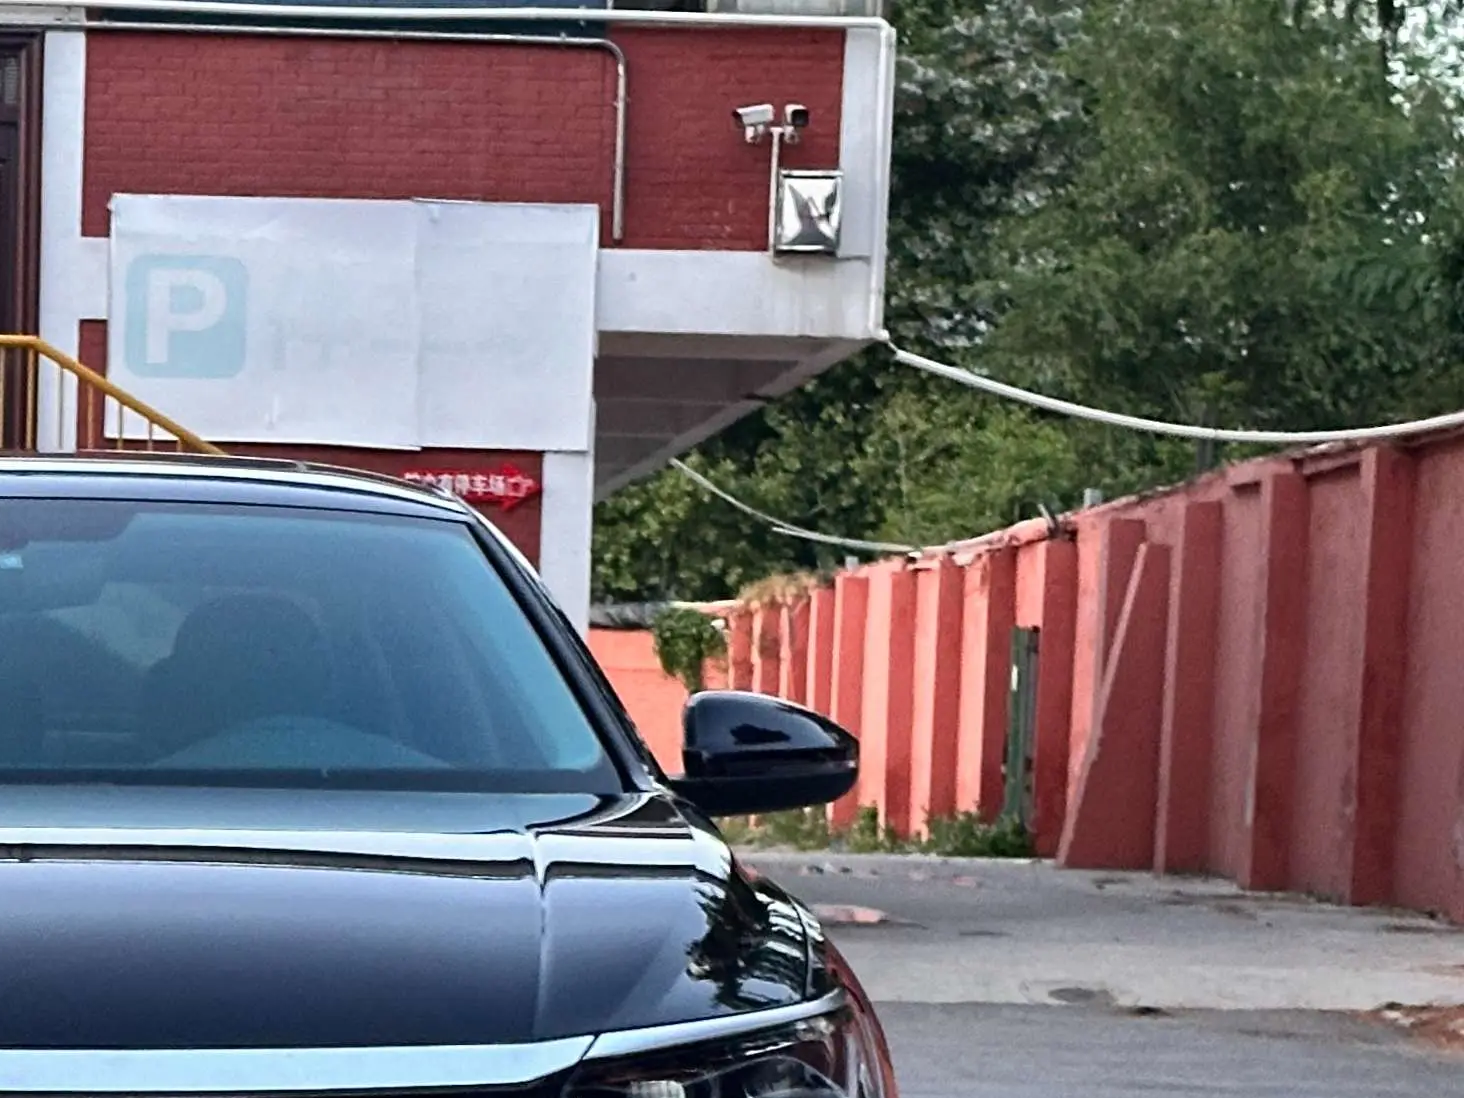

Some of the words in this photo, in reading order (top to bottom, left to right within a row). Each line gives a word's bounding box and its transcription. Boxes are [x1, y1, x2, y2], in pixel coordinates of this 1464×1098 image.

[144, 268, 227, 365] P
[403, 472, 505, 496] 有停车场
